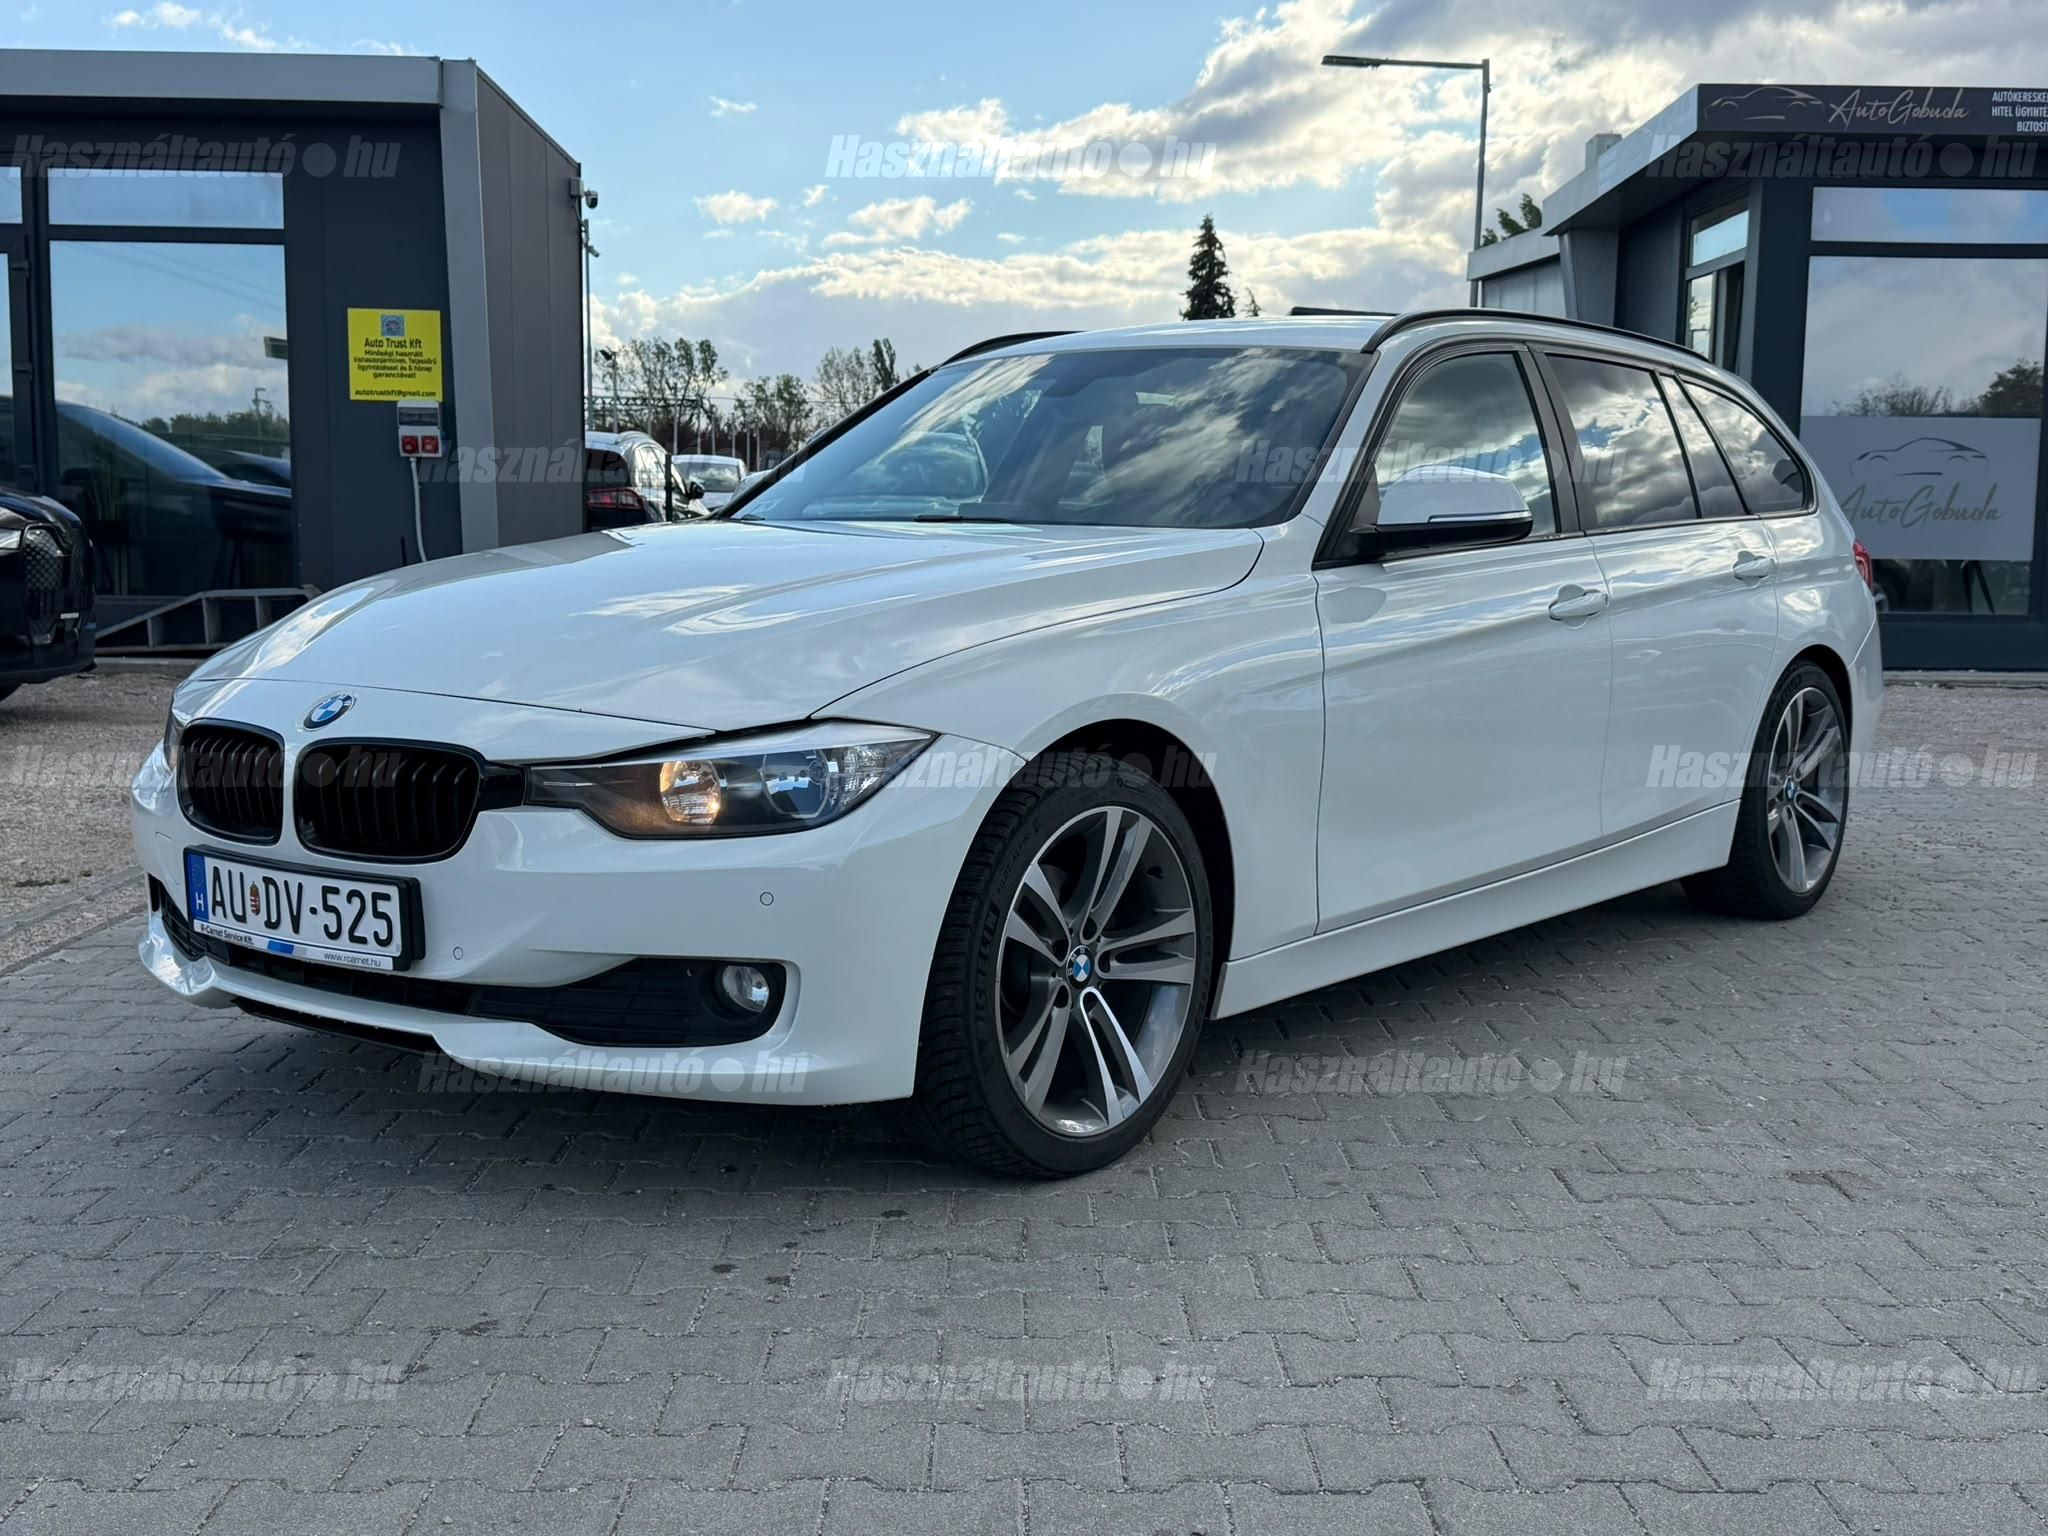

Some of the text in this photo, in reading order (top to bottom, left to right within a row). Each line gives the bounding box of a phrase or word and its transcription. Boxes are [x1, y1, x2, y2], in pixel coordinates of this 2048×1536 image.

[1992, 89, 2048, 103] AUTÓKERESKE
[1992, 105, 2014, 117] HITEL
[364, 338, 384, 348] Auto
[385, 338, 408, 349] Trust
[195, 892, 205, 911] H
[212, 865, 393, 947] AU DV-525
